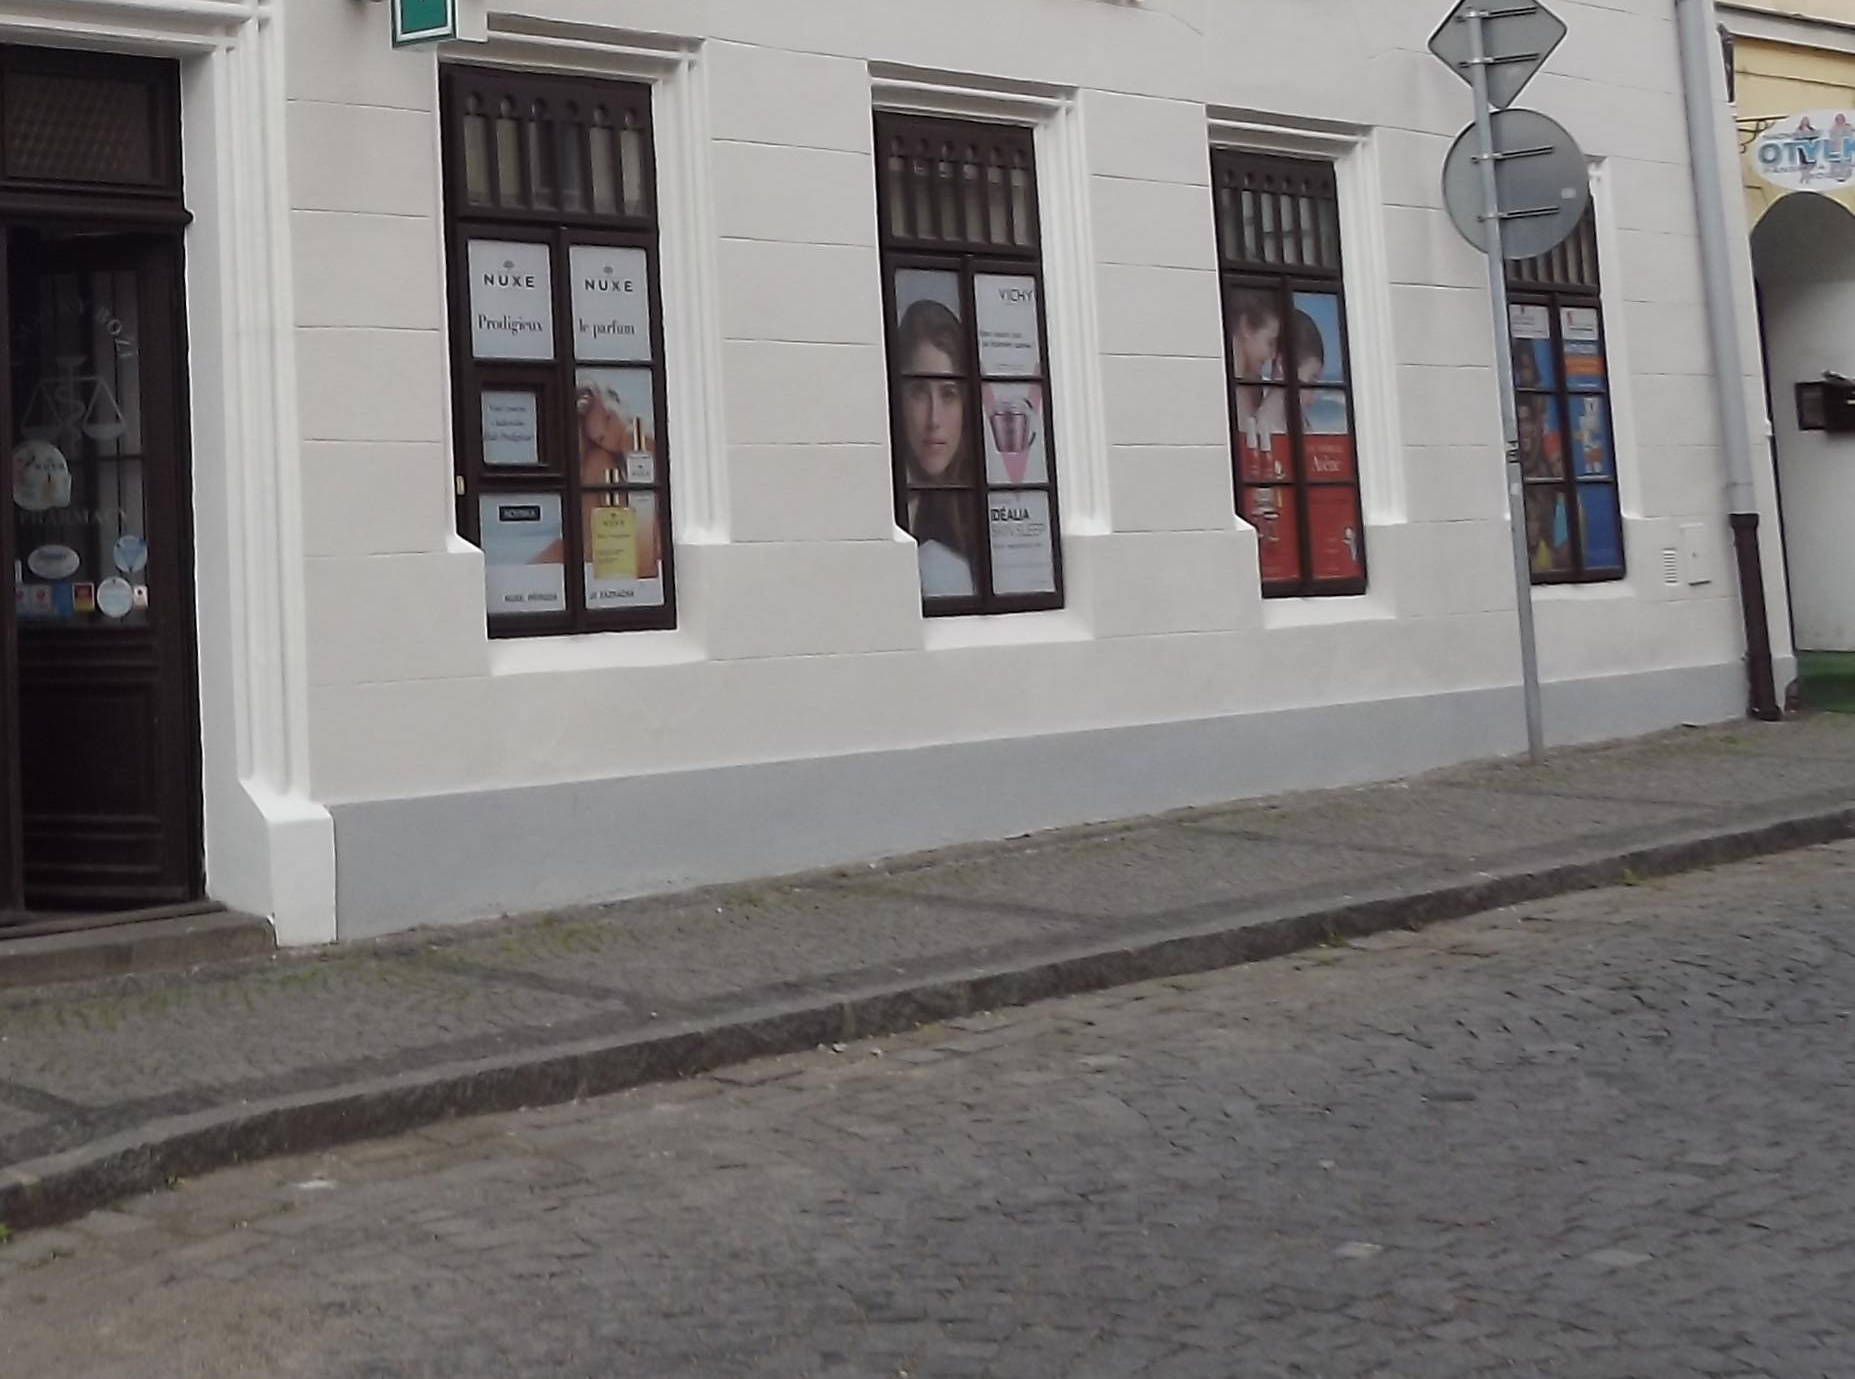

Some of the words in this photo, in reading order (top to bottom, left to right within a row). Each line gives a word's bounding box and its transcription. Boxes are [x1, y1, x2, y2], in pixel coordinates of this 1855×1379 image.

[483, 273, 536, 288] NUXE
[584, 279, 634, 293] NUXE
[998, 288, 1034, 302] VICHY
[477, 313, 544, 336] Prodigieux
[593, 319, 635, 339] parfum
